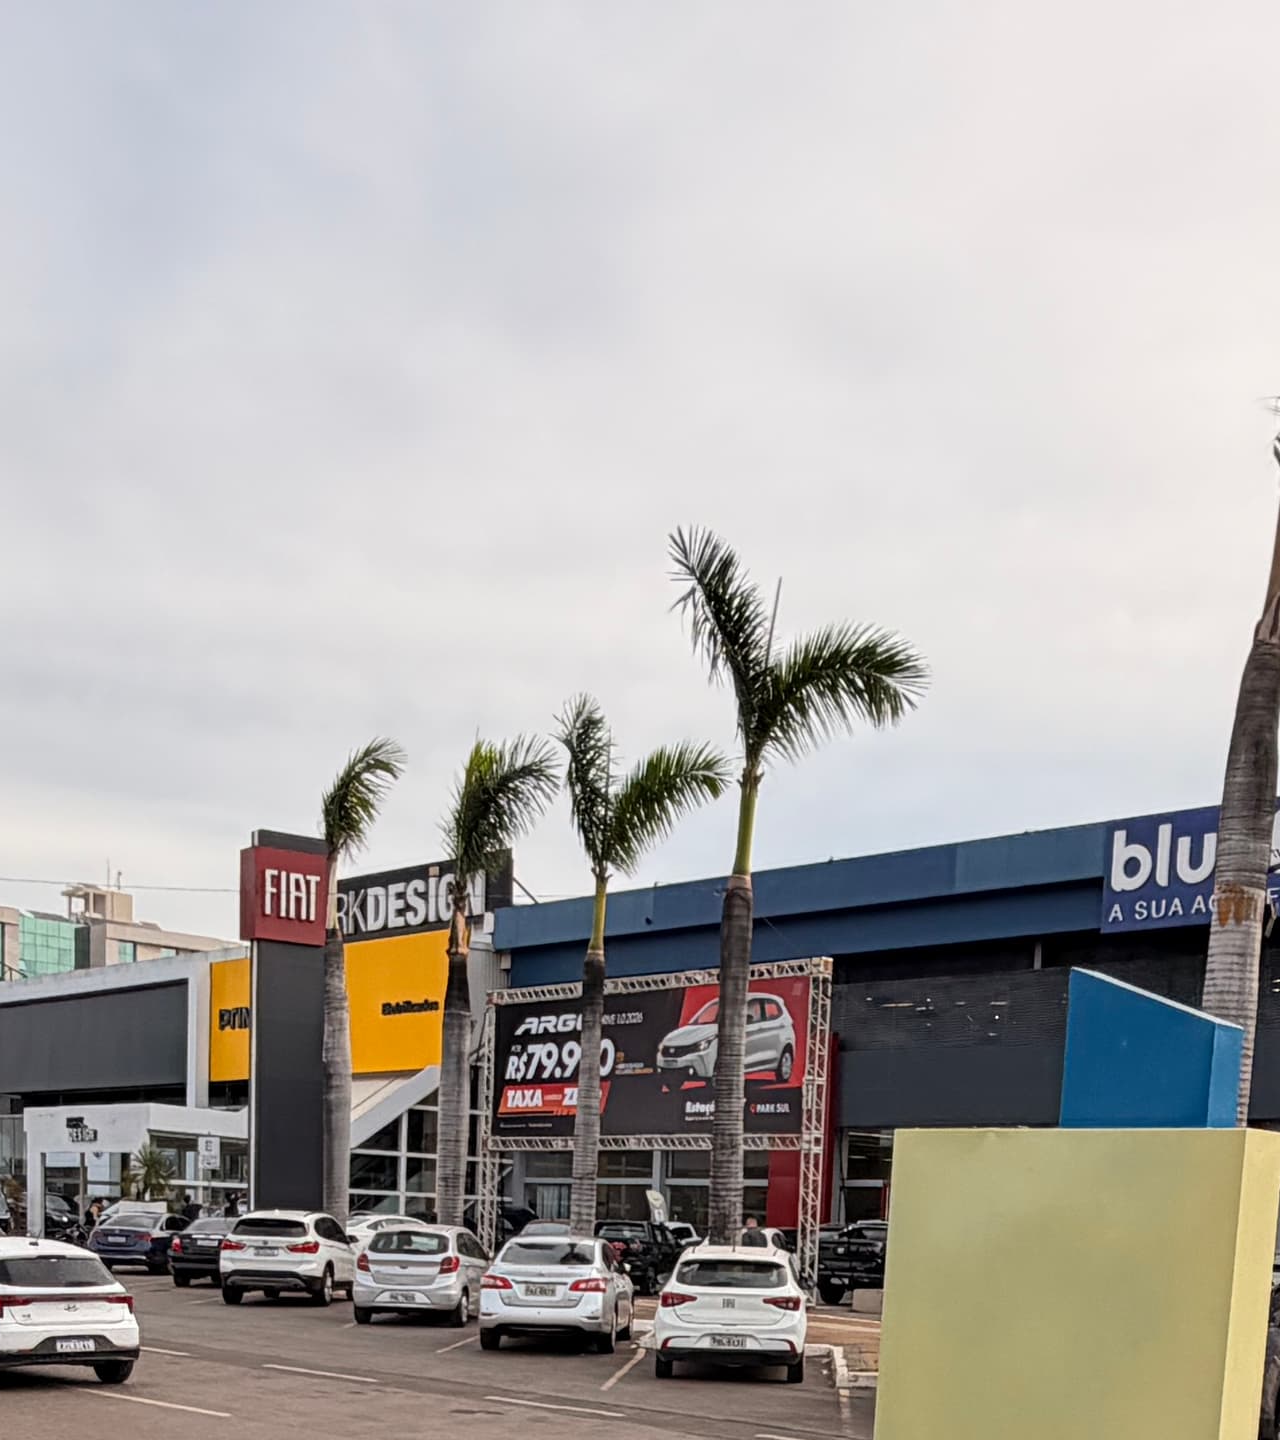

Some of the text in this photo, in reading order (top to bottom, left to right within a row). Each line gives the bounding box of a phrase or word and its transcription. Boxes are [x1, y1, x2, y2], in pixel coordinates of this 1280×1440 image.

[264, 868, 320, 921] FIAT
[337, 870, 486, 935] RKDESIGN
[1108, 904, 1123, 923] A
[1134, 898, 1183, 920] SUA
[514, 1013, 582, 1035] ARG
[505, 1038, 615, 1082] R$79.90
[506, 1089, 543, 1108] TAXA
